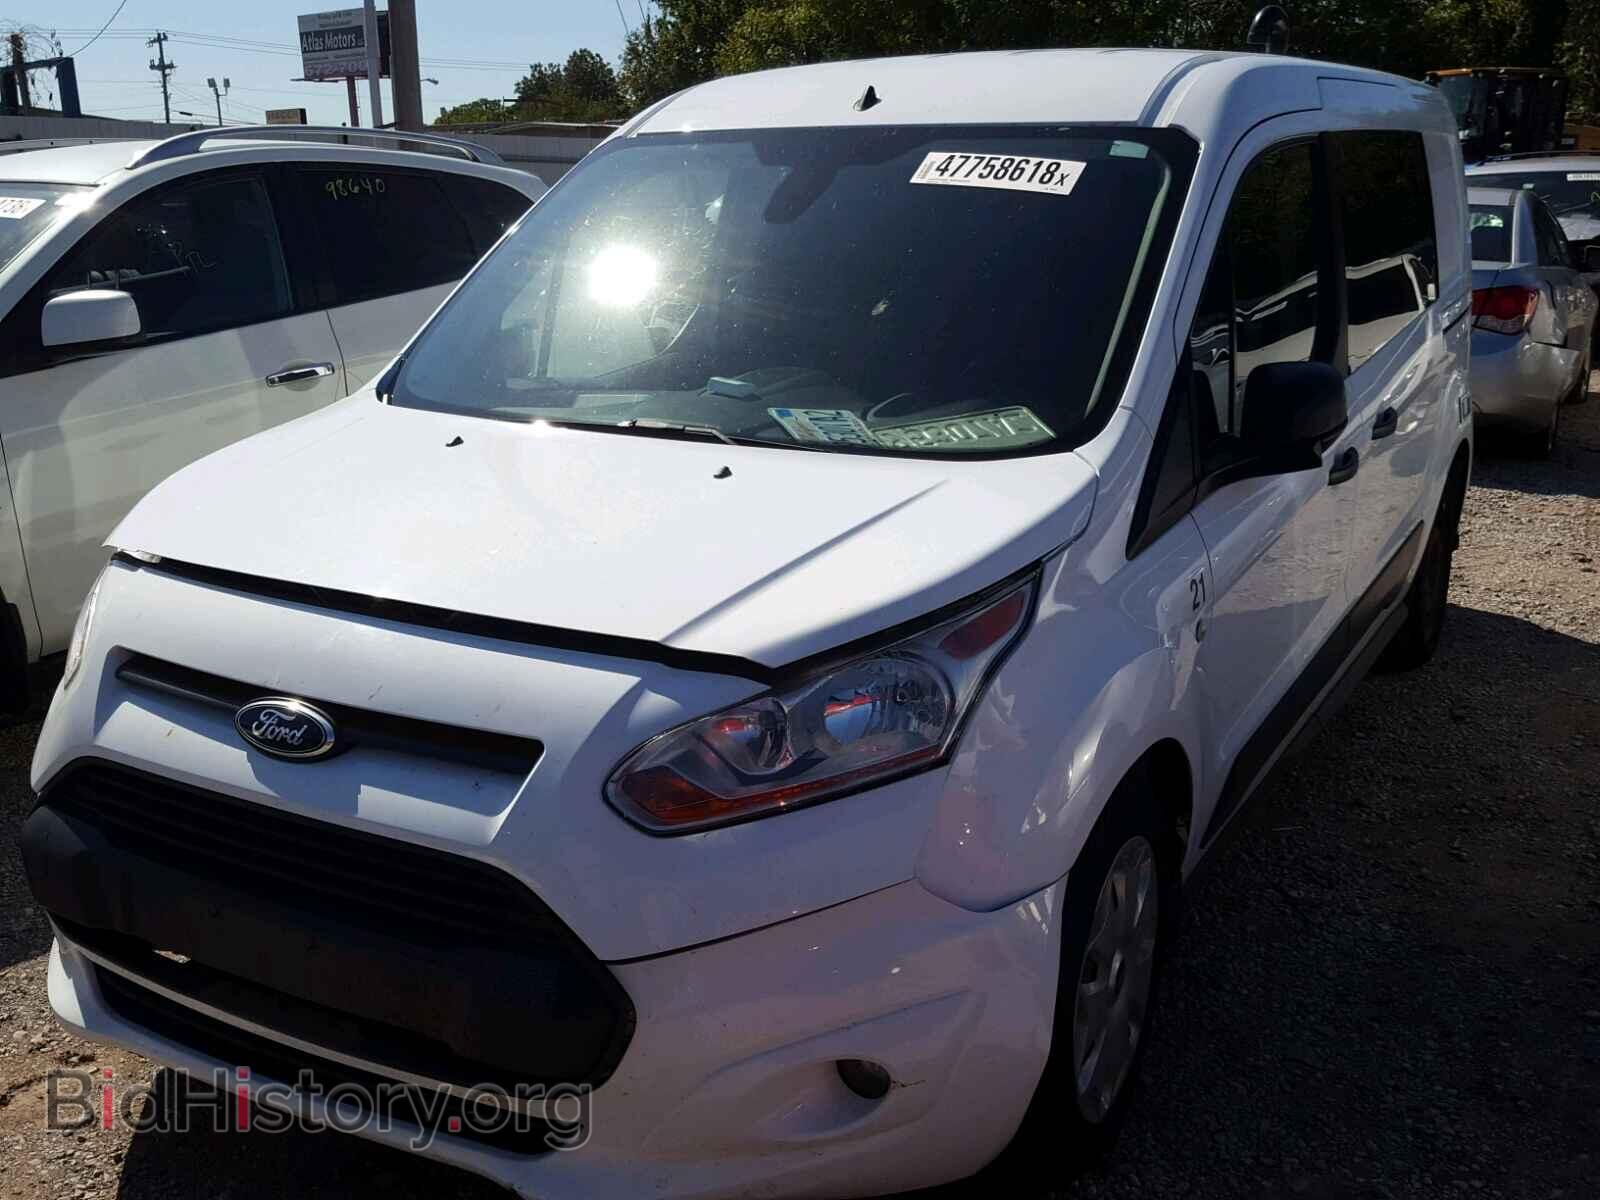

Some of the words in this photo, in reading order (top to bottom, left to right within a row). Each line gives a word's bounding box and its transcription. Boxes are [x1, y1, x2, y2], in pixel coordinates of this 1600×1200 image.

[302, 32, 324, 52] Atlas
[325, 31, 356, 50] Motors
[326, 178, 385, 200] 98640
[1190, 572, 1206, 612] 21
[251, 709, 309, 746] Ford
